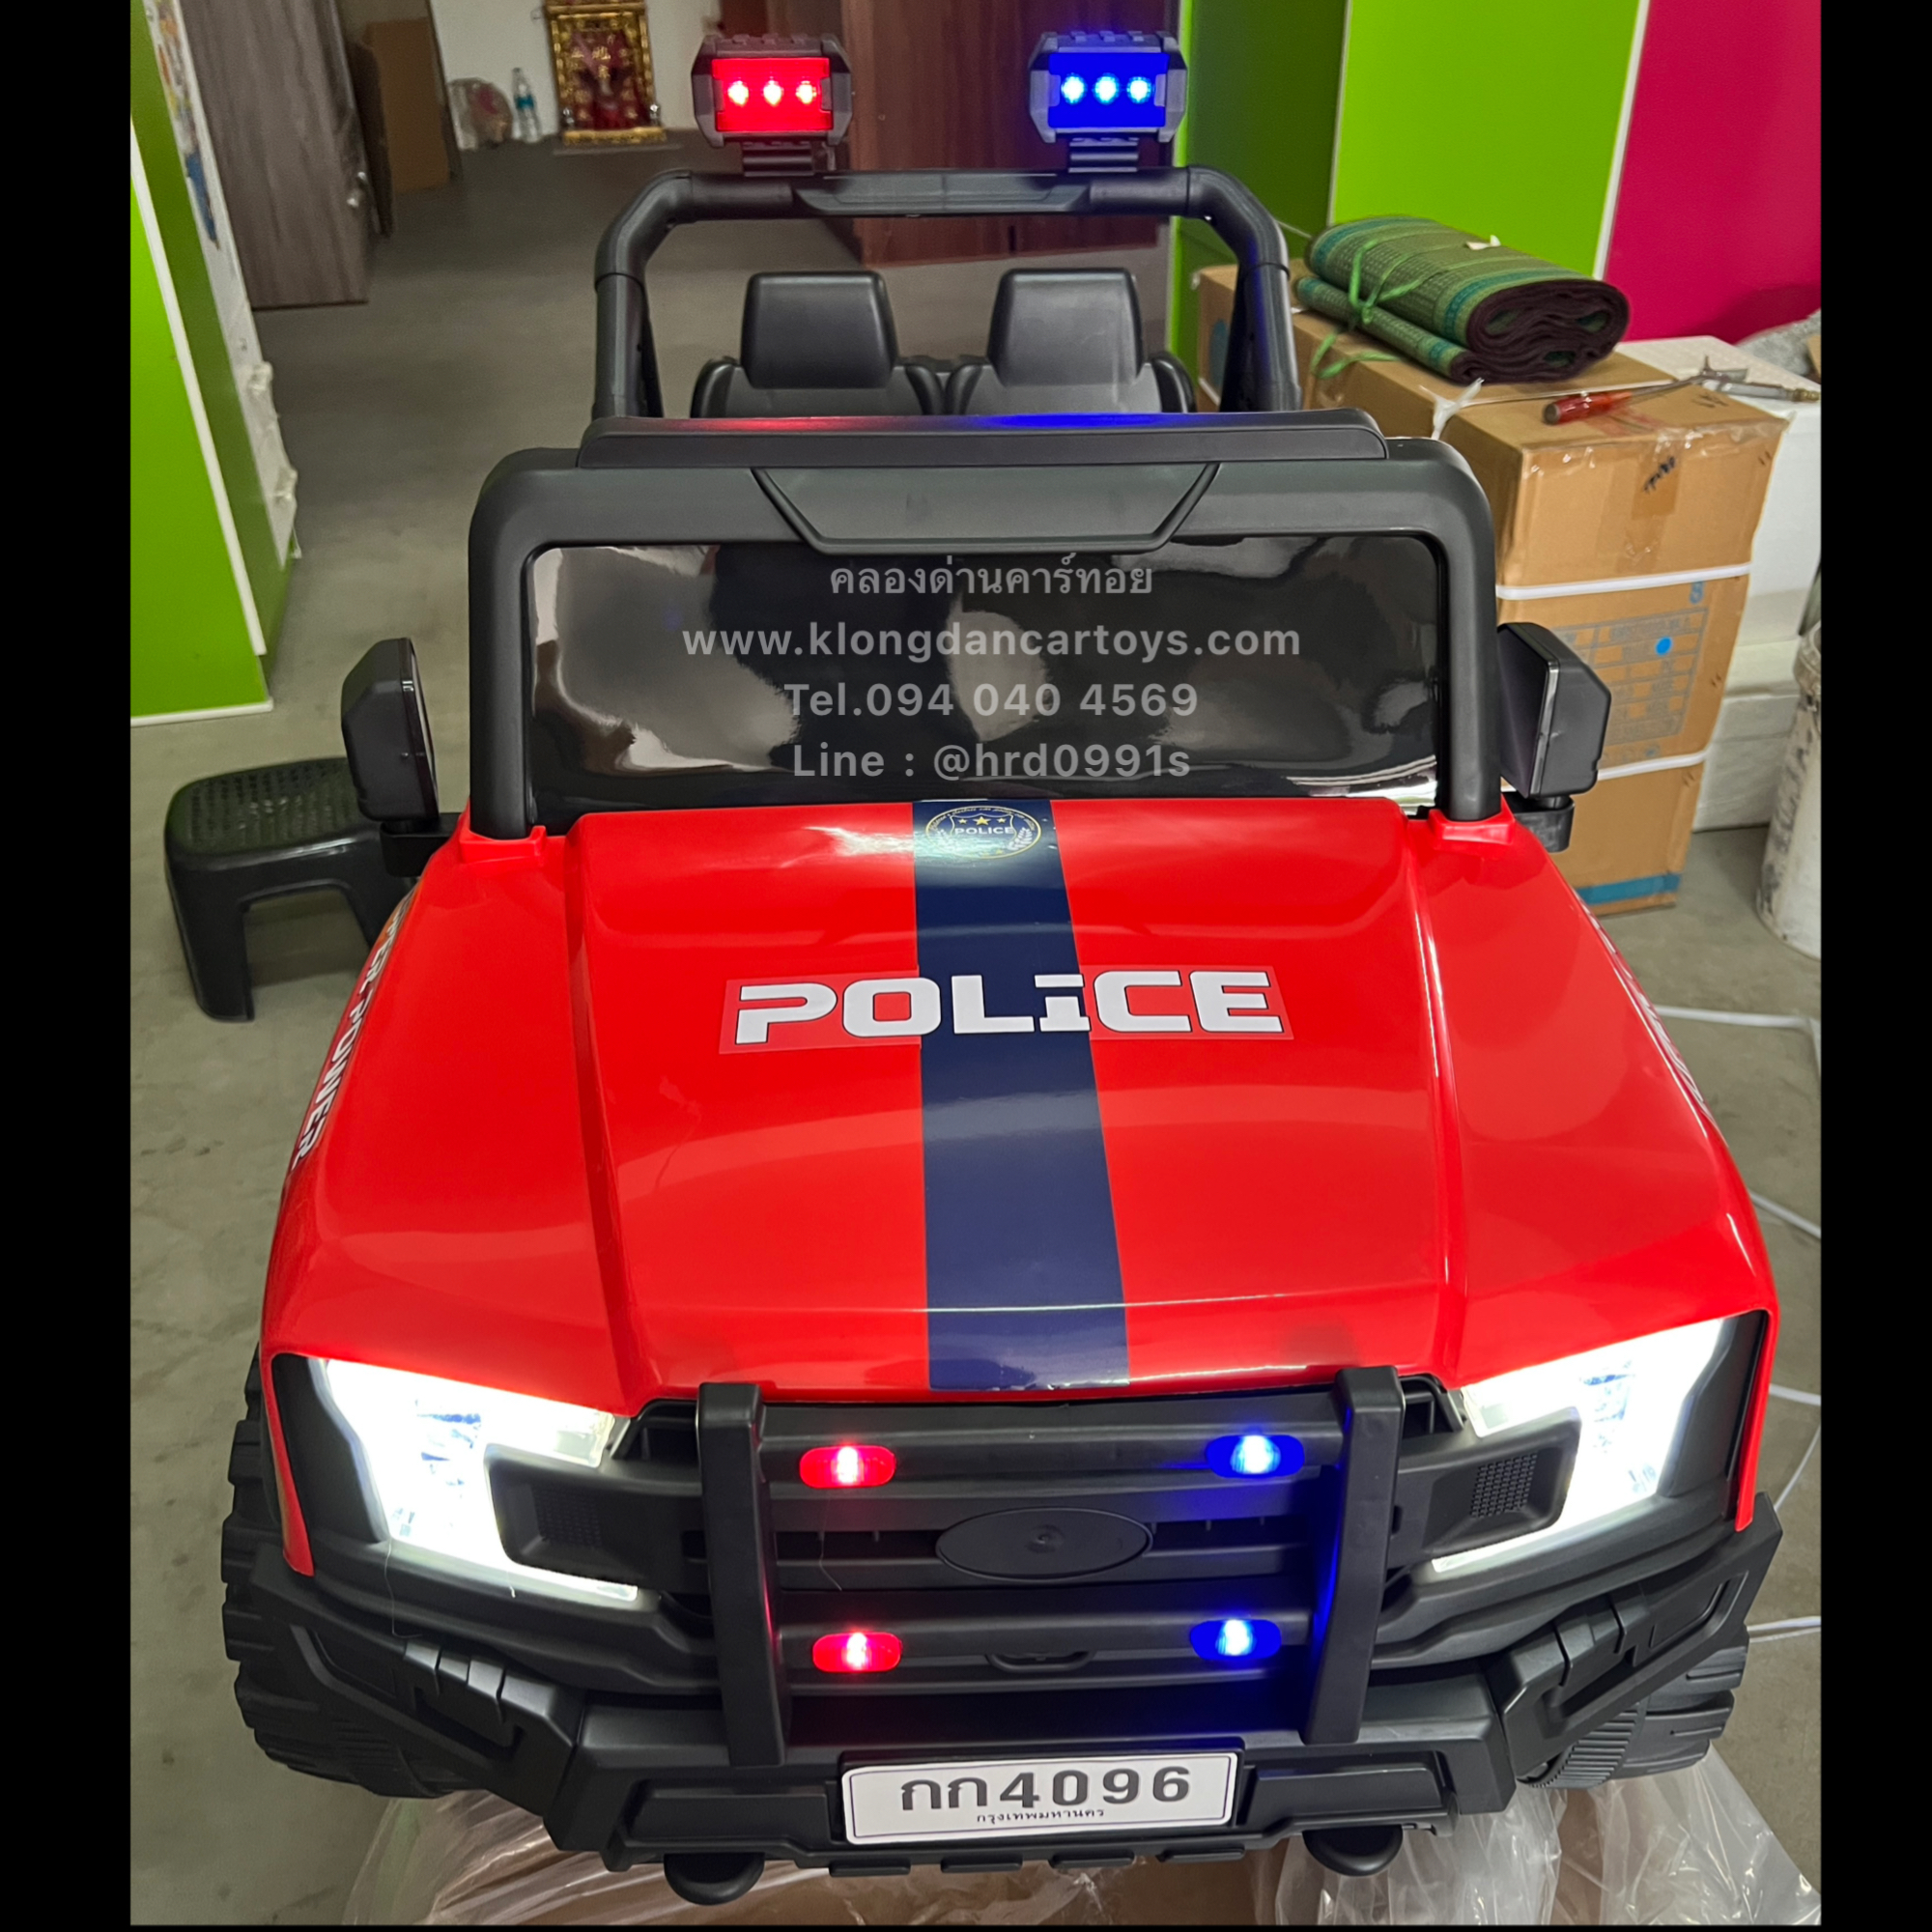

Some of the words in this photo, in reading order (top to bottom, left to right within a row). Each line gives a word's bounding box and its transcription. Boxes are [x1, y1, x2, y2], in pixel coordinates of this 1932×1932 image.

[977, 1809, 1105, 1825] กรุงเทพมหานคร
